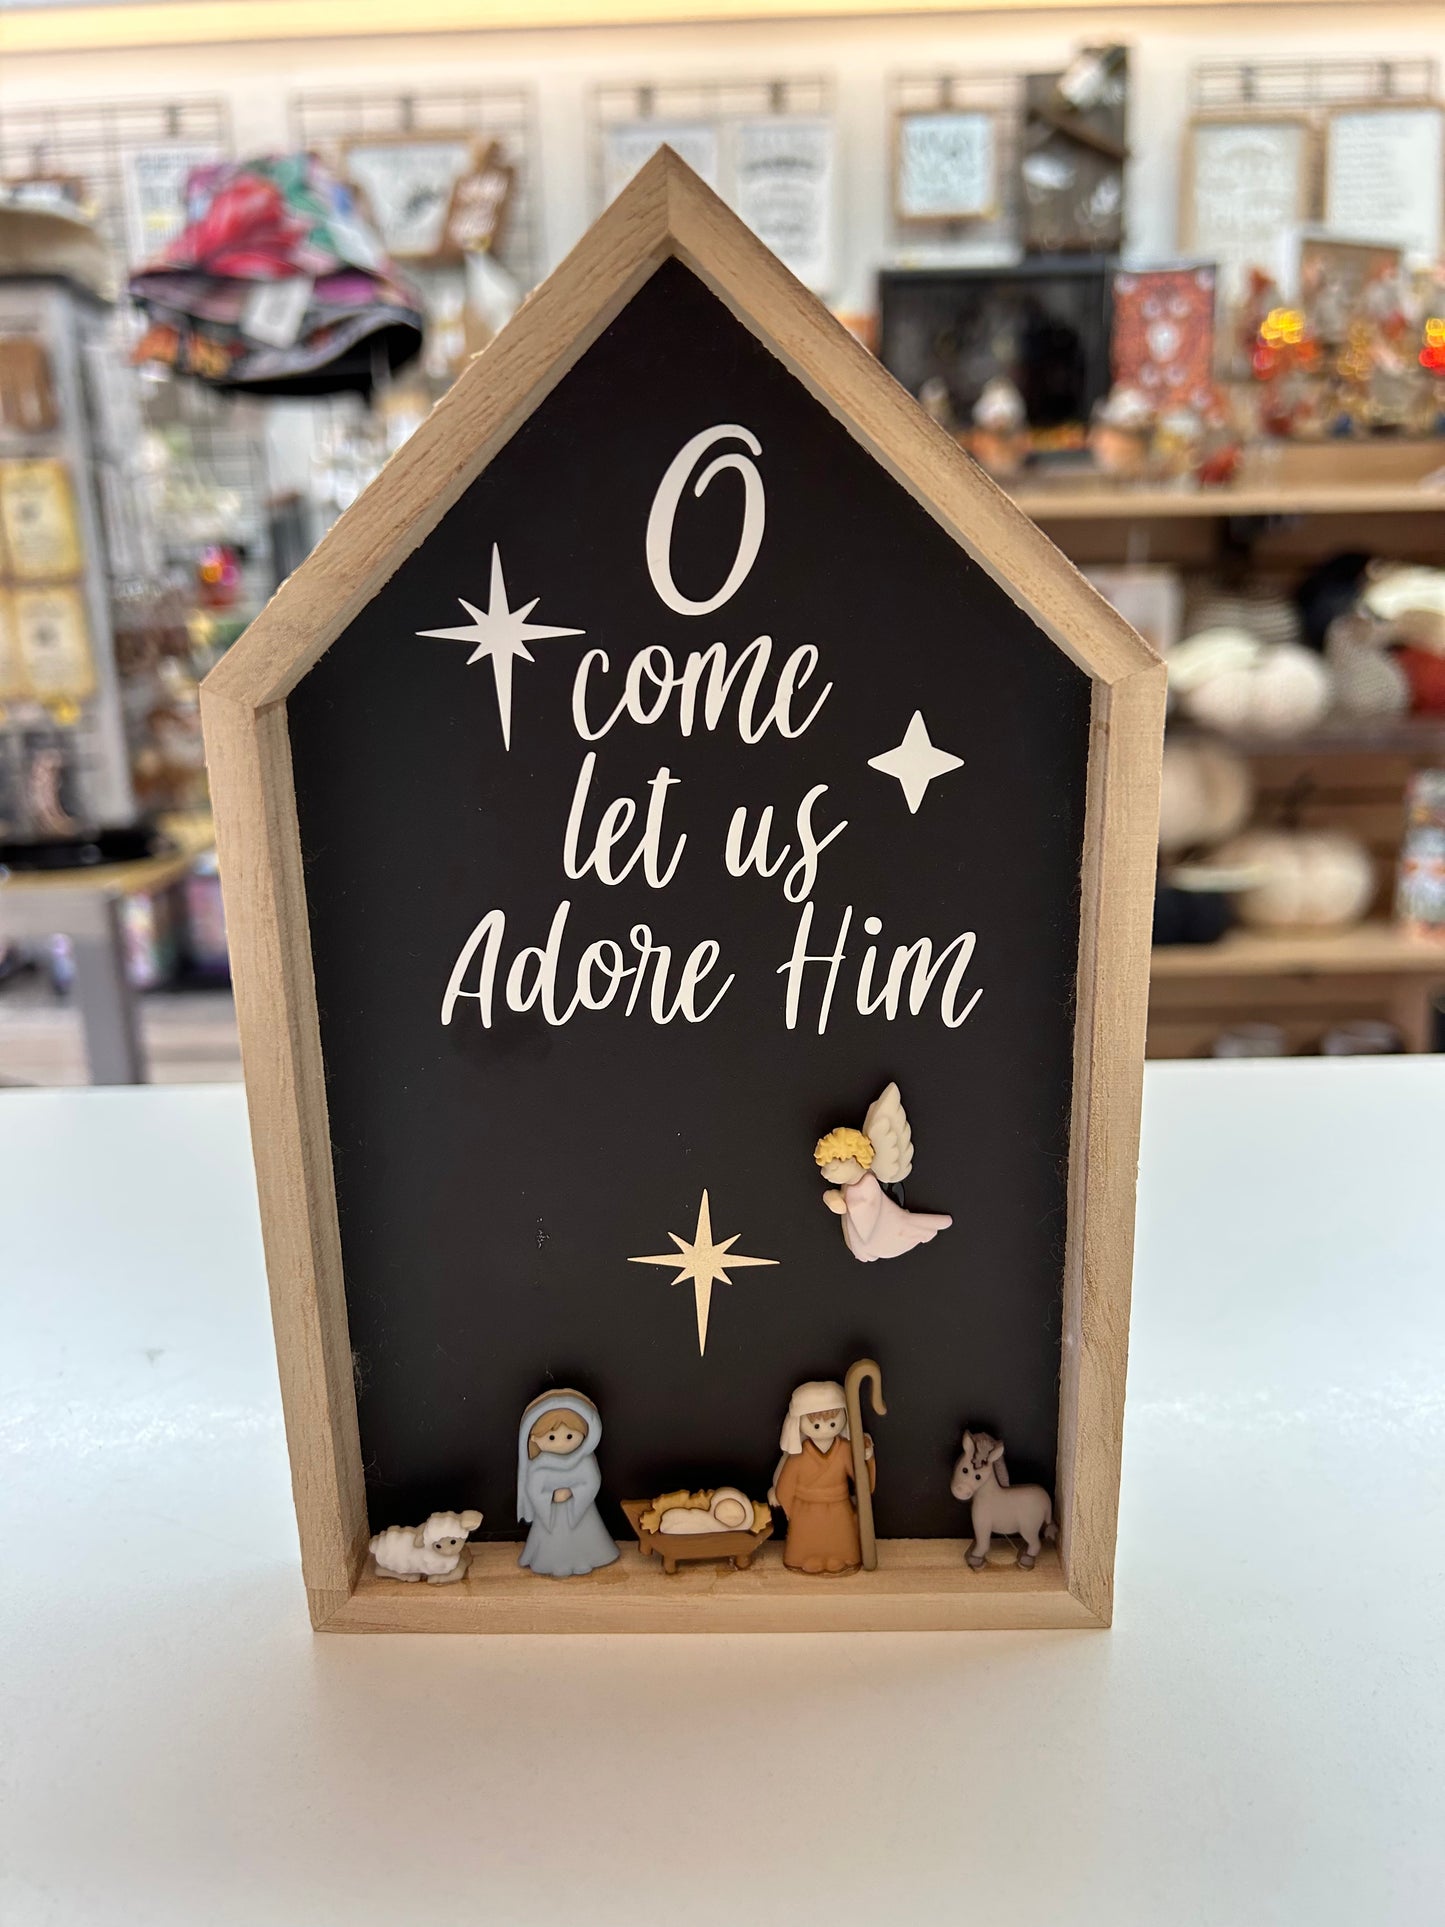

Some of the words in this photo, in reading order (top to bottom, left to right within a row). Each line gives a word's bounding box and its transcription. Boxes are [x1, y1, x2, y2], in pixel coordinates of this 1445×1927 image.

[646, 424, 765, 615] O
[573, 636, 833, 744] come
[564, 752, 687, 888] let
[725, 784, 848, 902] us
[441, 901, 735, 1028] Adore
[776, 901, 983, 1035] Him
